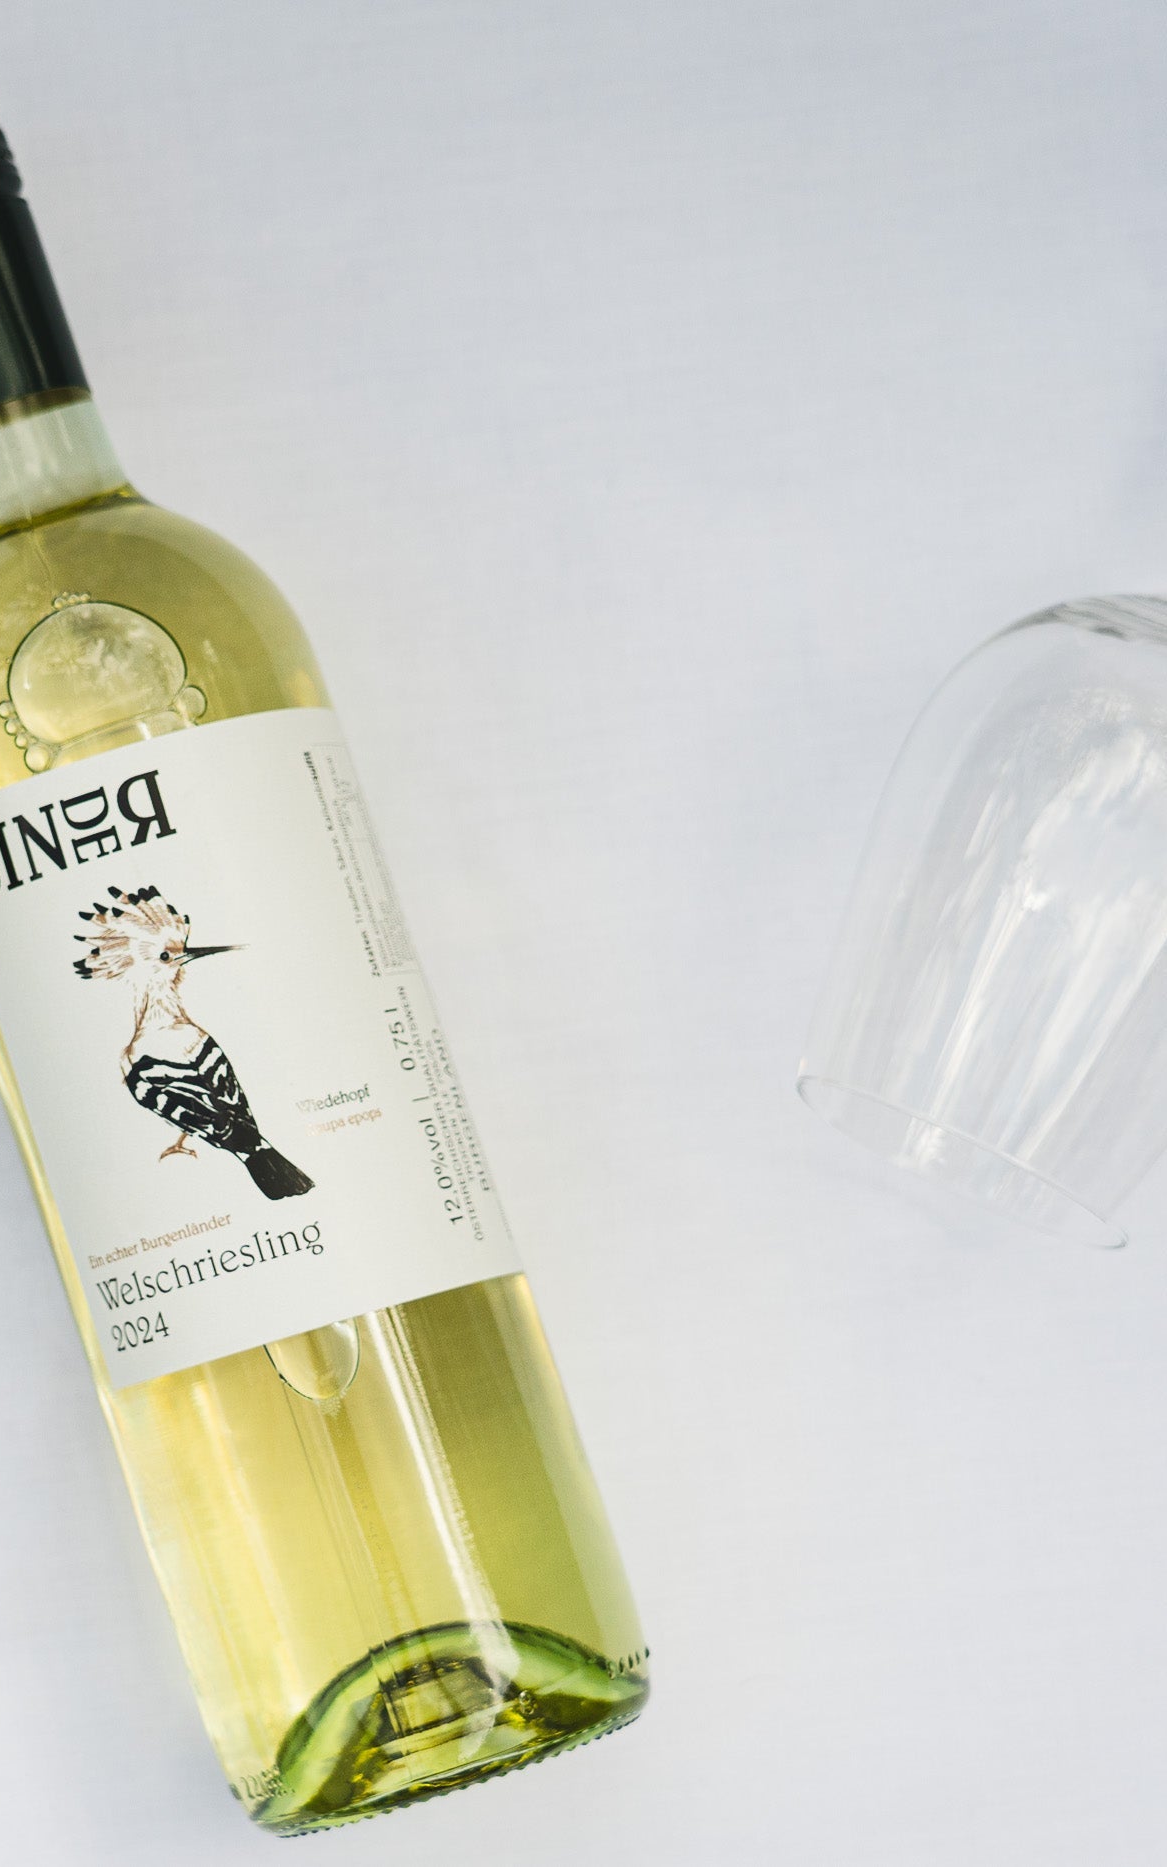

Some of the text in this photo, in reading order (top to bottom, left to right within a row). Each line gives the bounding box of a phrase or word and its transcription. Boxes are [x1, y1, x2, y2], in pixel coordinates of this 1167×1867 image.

[347, 1107, 383, 1126] epops
[88, 1213, 232, 1270] Ein echter Burgenländer
[96, 1220, 325, 1311] Welschriesling
[110, 1311, 170, 1352] 2024
